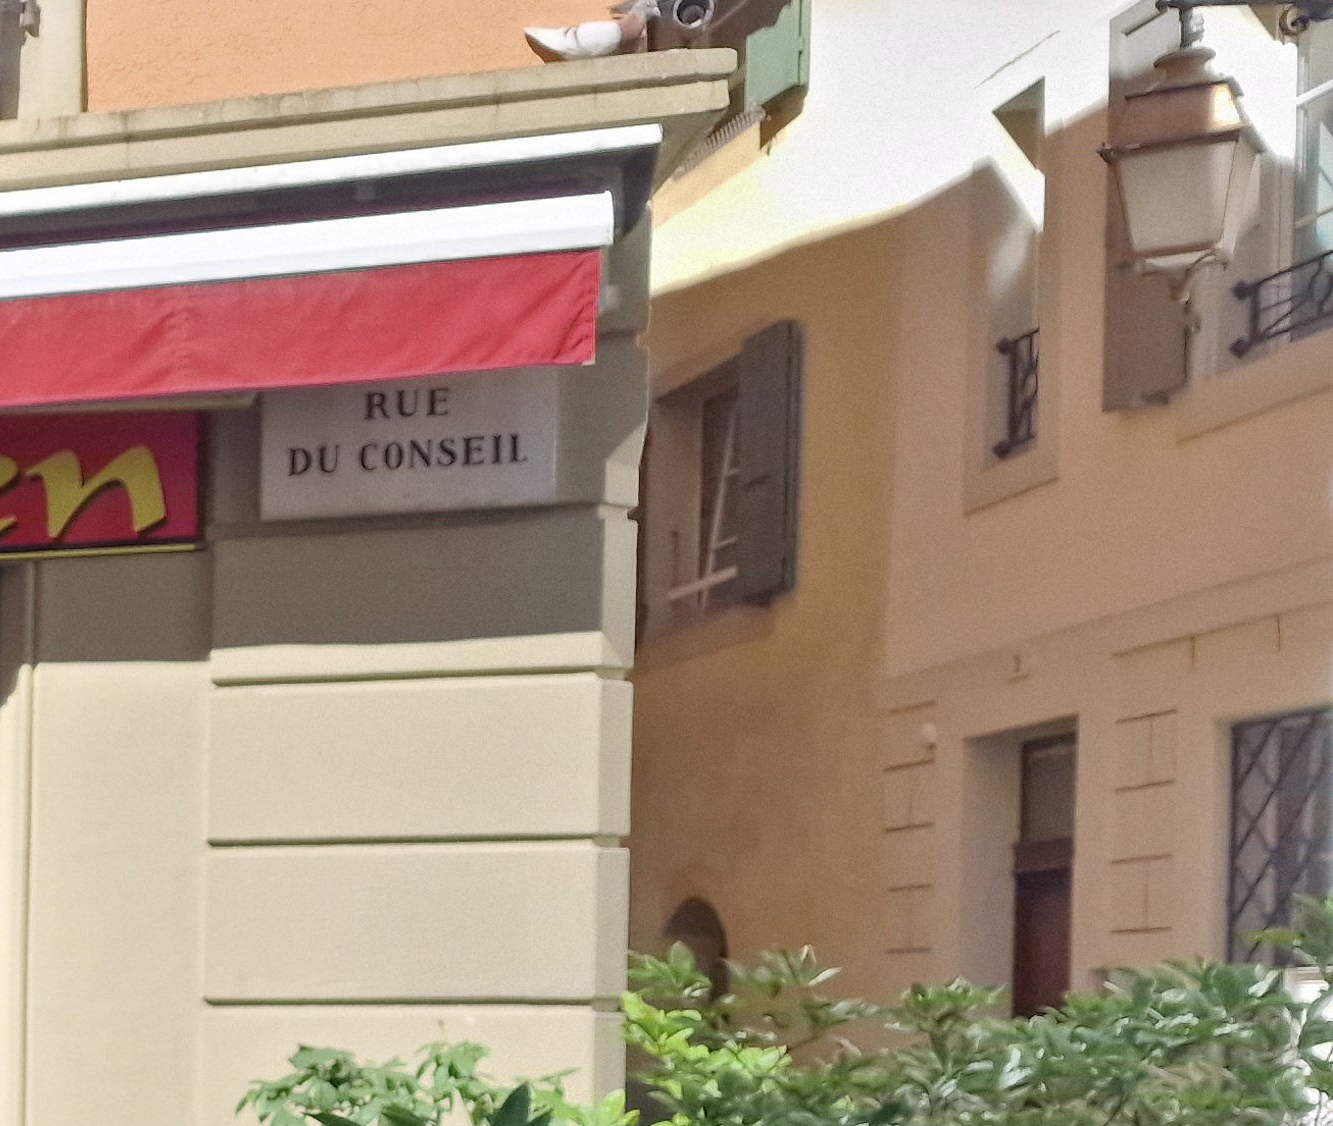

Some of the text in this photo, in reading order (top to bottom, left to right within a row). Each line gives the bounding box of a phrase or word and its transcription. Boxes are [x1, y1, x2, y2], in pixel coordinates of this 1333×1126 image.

[363, 387, 449, 420] RUE
[287, 433, 529, 476] DU CONSEIL
